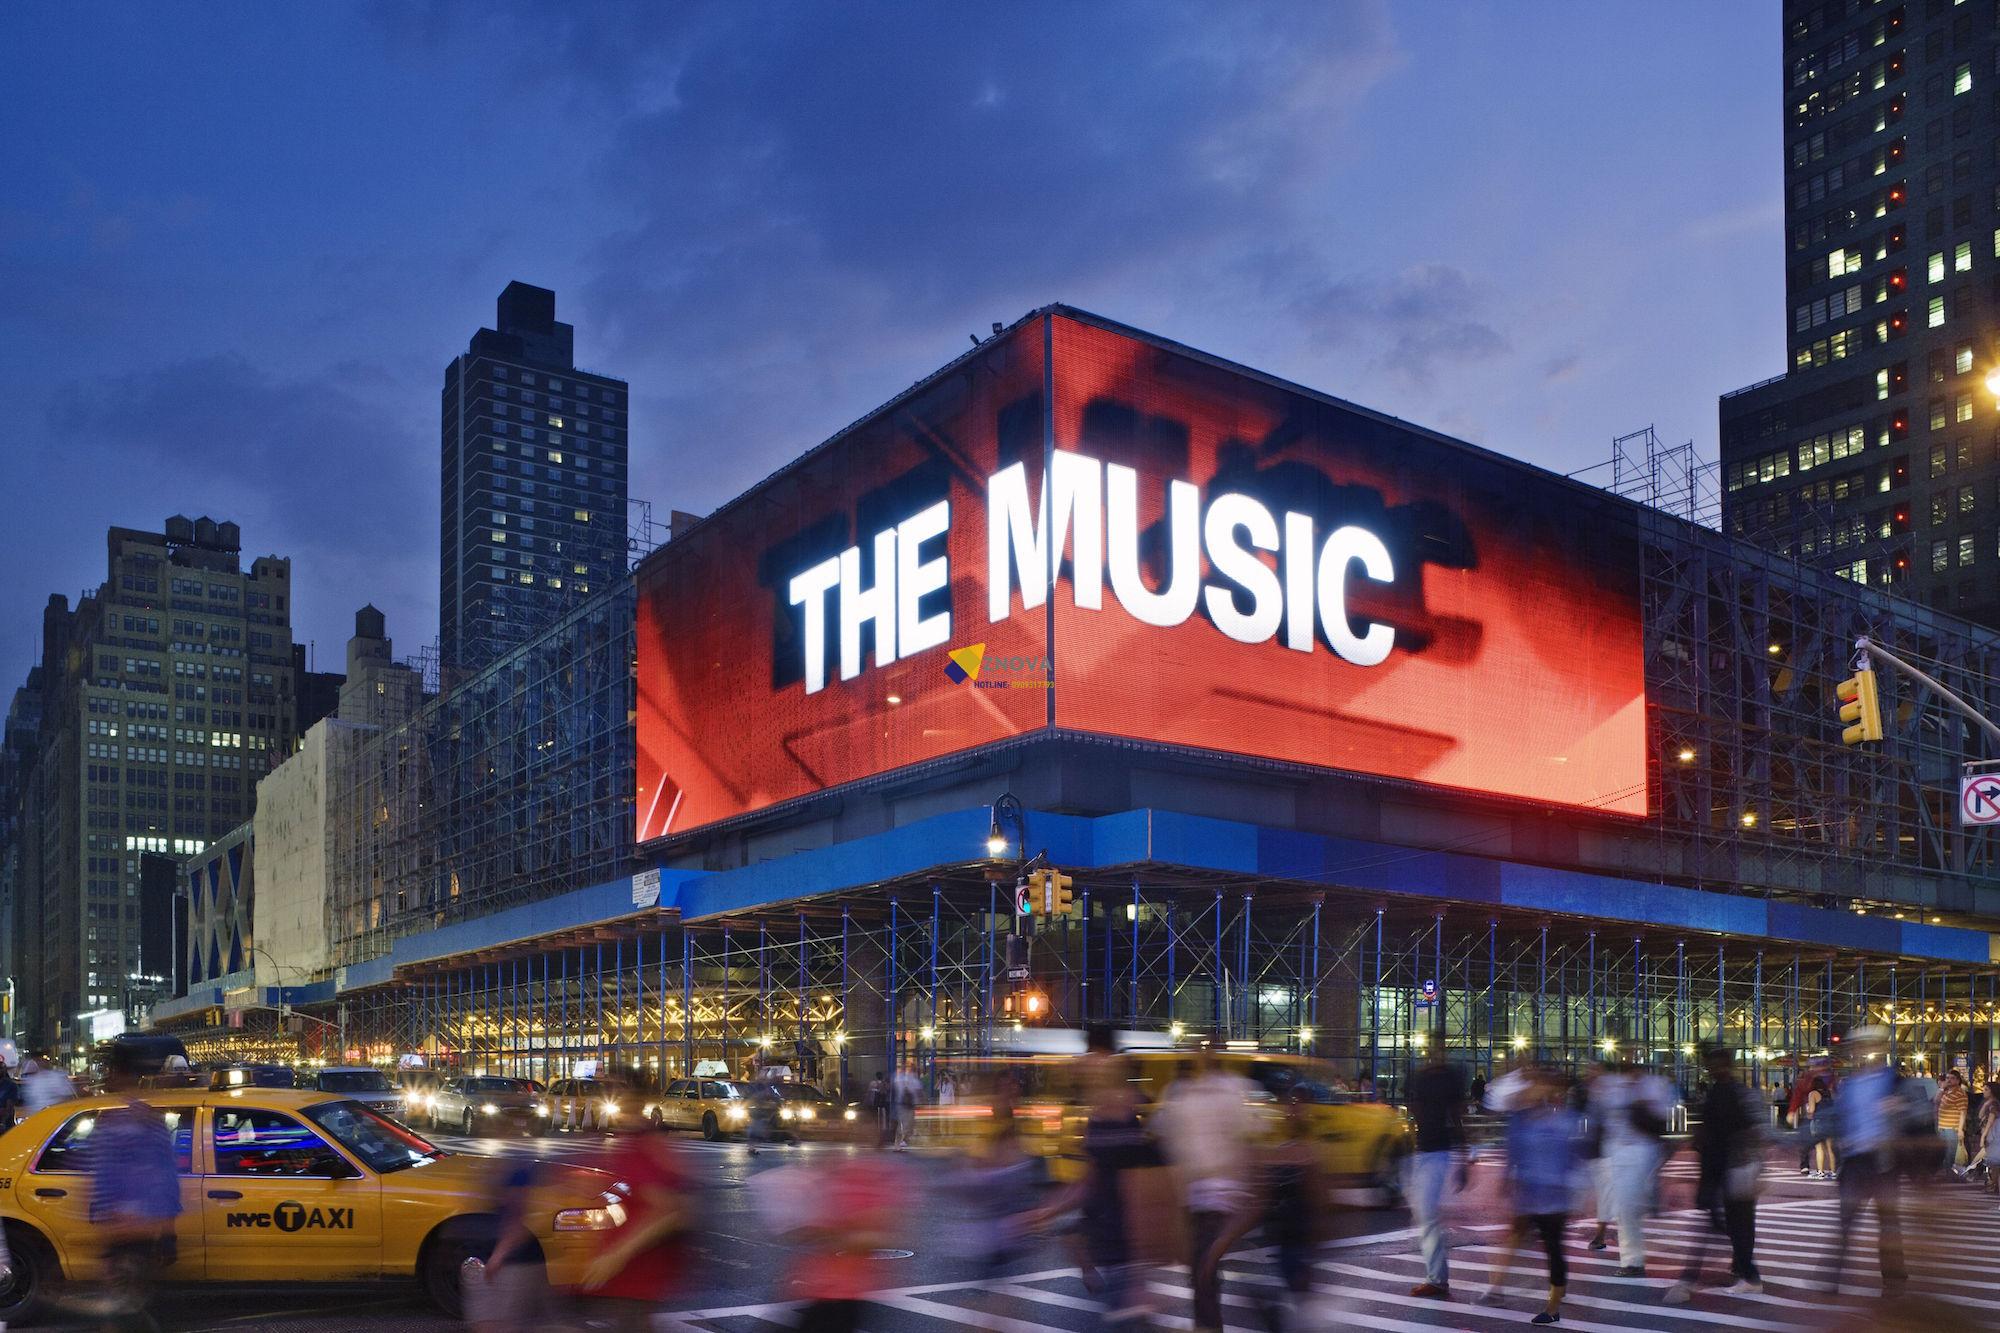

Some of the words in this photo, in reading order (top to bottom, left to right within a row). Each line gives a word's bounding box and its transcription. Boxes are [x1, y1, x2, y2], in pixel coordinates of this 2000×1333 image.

[787, 500, 951, 695] THE
[988, 449, 1395, 667] MUSIC
[227, 1213, 272, 1228] NYC
[279, 1204, 354, 1229] TAXI
